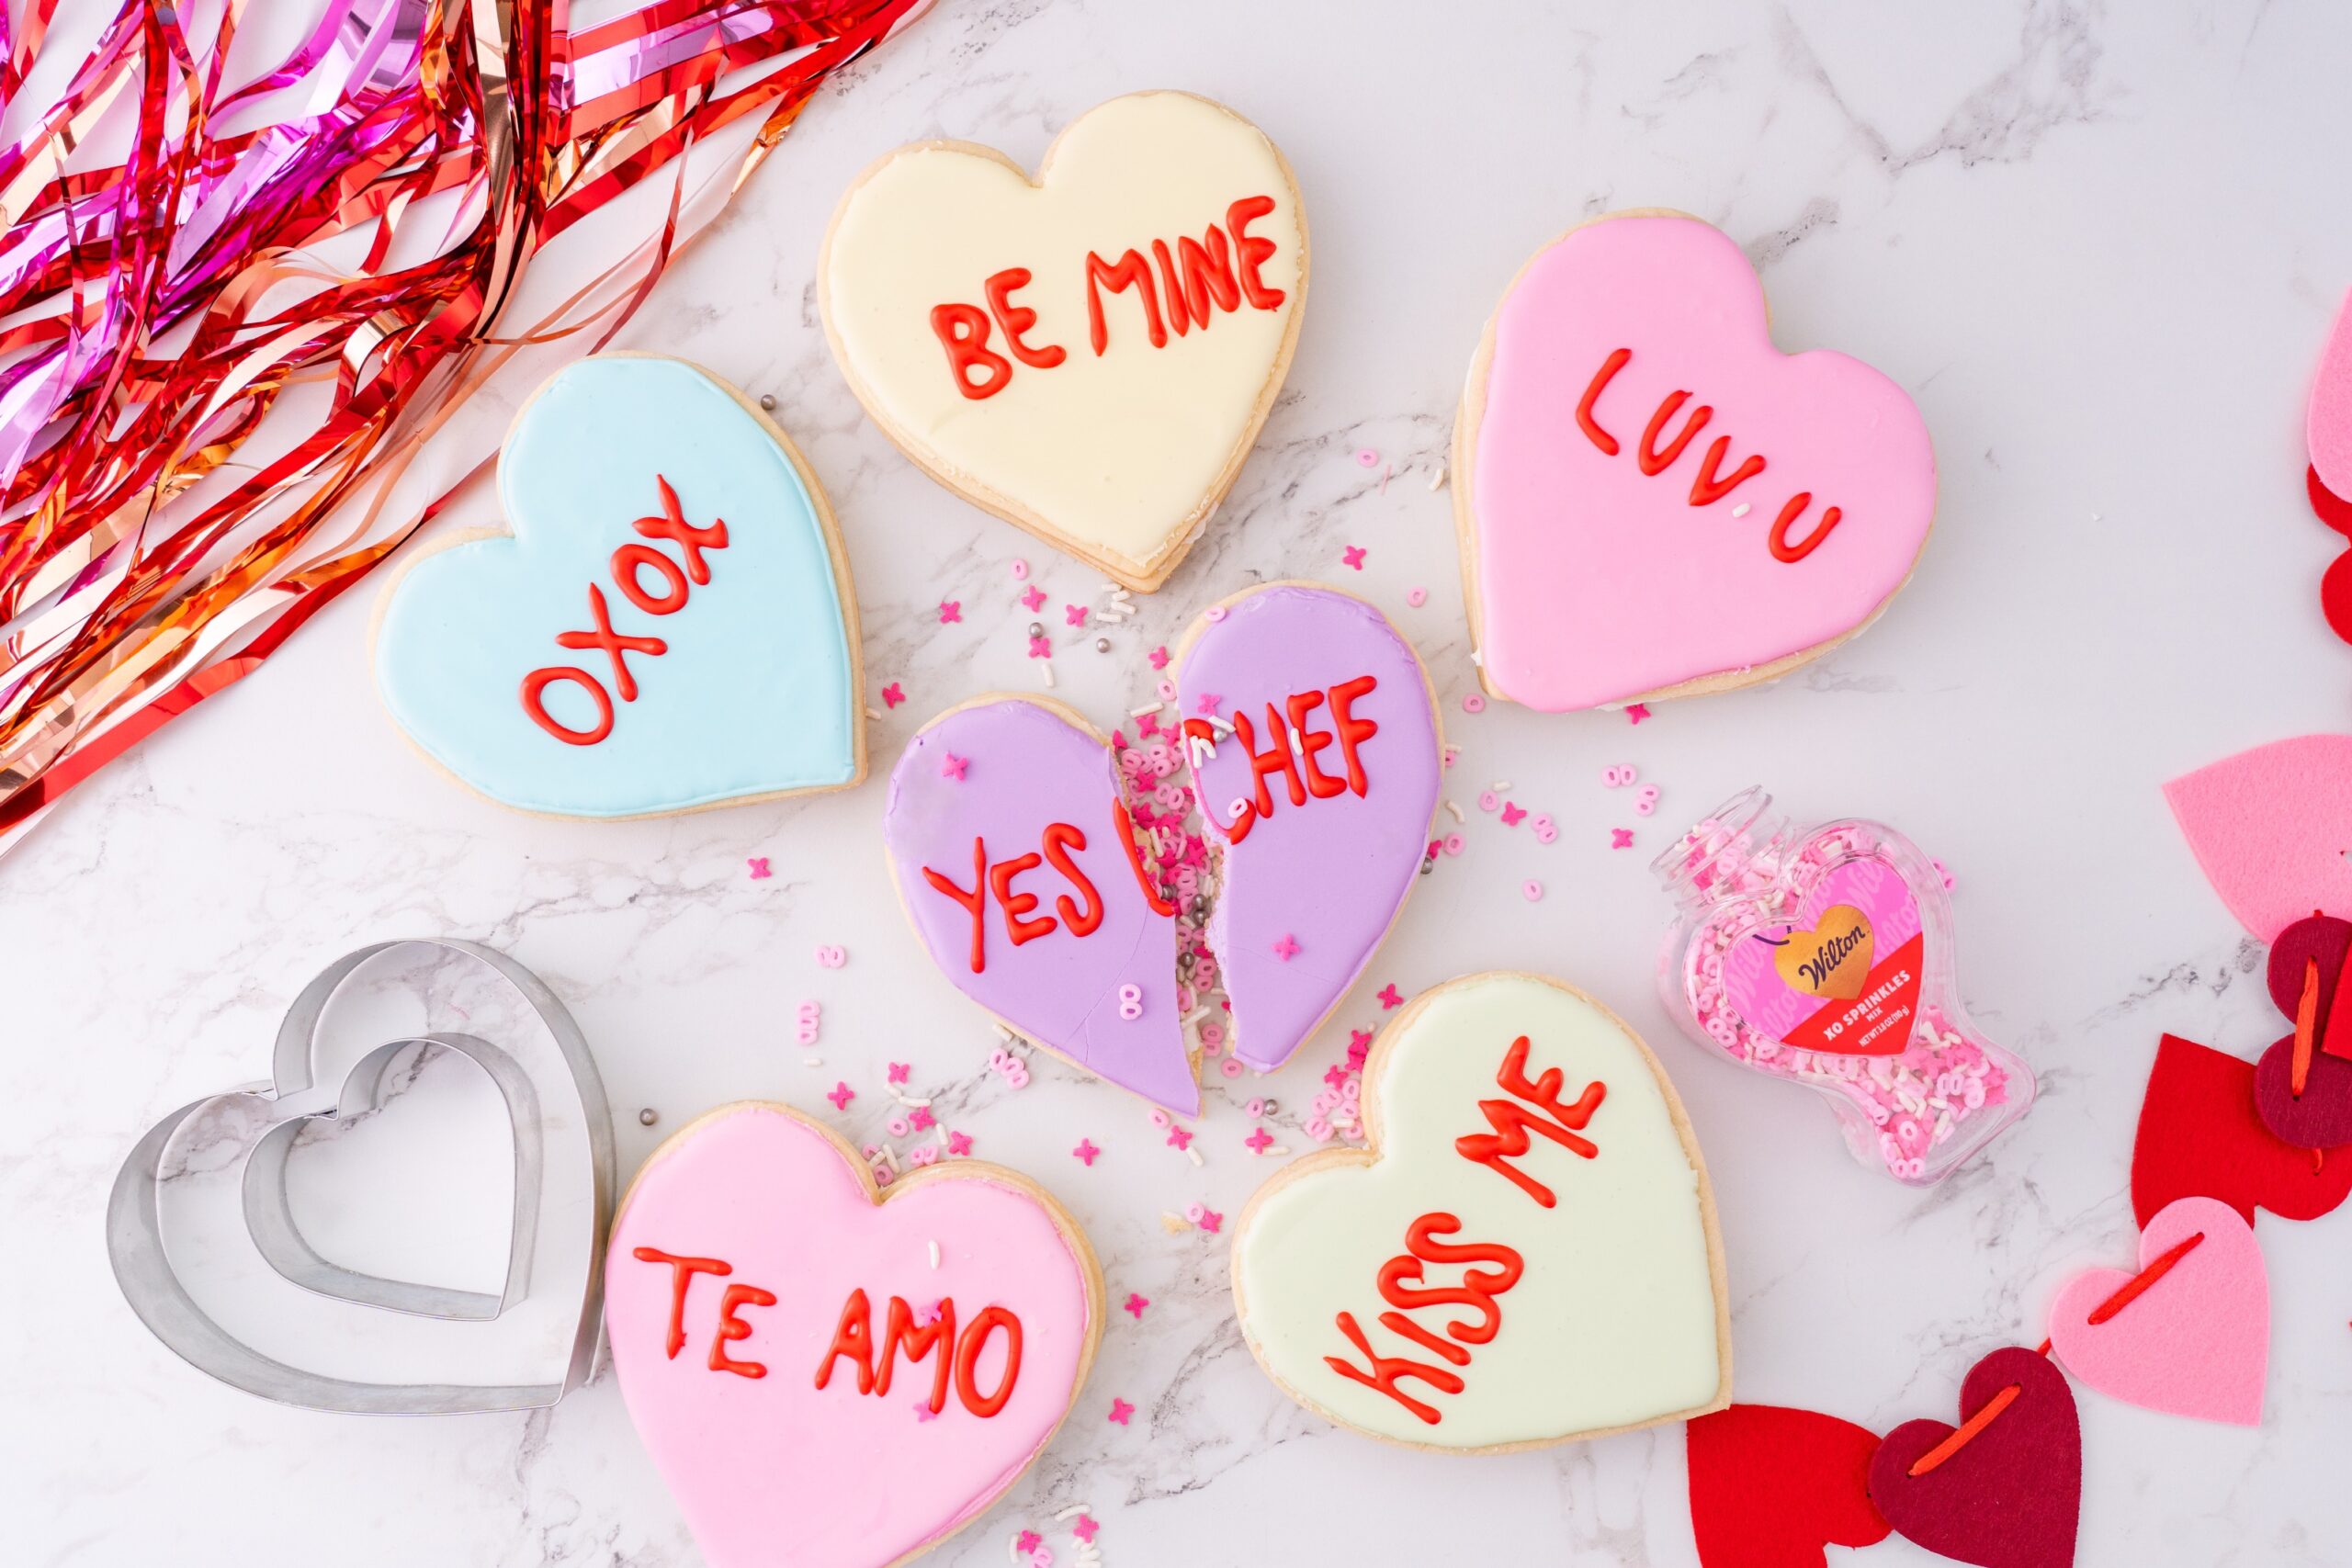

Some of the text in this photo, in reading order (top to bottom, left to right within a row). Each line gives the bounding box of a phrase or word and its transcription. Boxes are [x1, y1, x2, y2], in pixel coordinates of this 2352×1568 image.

[930, 194, 1286, 401] BE MINE
[1574, 347, 1843, 564] LUV U
[519, 473, 730, 748] OXOX
[921, 821, 1105, 975] YES
[1798, 925, 1866, 990] Wilton
[1823, 1021, 1844, 1041] XO
[1842, 970, 1910, 1026] SPRINKLES
[1859, 1034, 1871, 1046] NET
[1868, 1028, 1879, 1039] WT
[1883, 1016, 1894, 1027] OZ
[1866, 1006, 1883, 1021] MIX
[1323, 1034, 1608, 1427] KISS ME
[633, 1246, 1023, 1419] TE AMO
